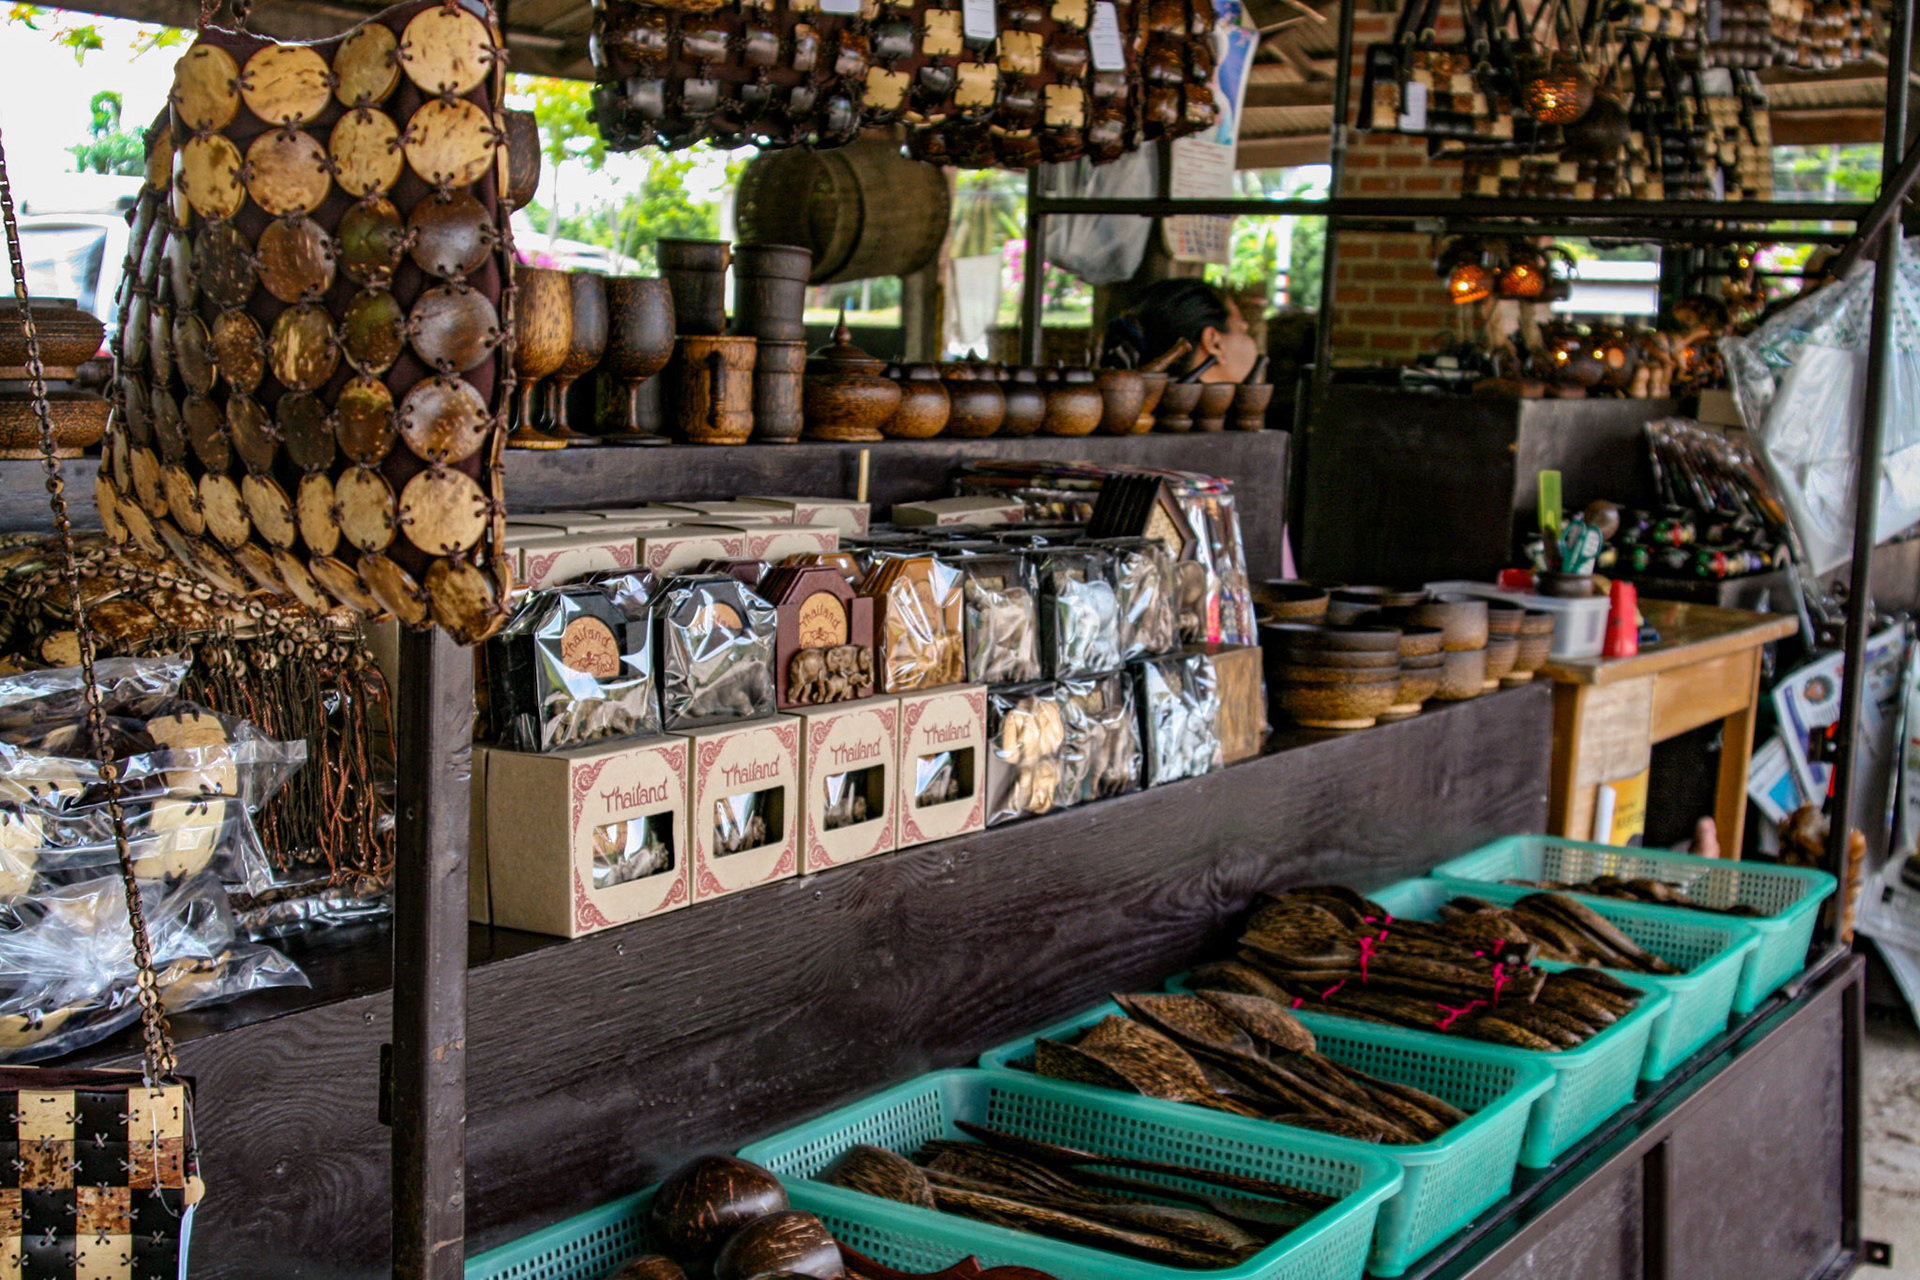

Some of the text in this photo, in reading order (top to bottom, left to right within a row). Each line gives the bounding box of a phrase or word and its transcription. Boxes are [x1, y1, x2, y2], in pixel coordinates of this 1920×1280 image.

[799, 603, 841, 630] Thailand
[562, 626, 611, 659] Thailand
[922, 720, 971, 745] Thailand
[830, 738, 881, 766] Thailand
[721, 755, 781, 787] Thailand
[601, 777, 668, 813] Thailand
